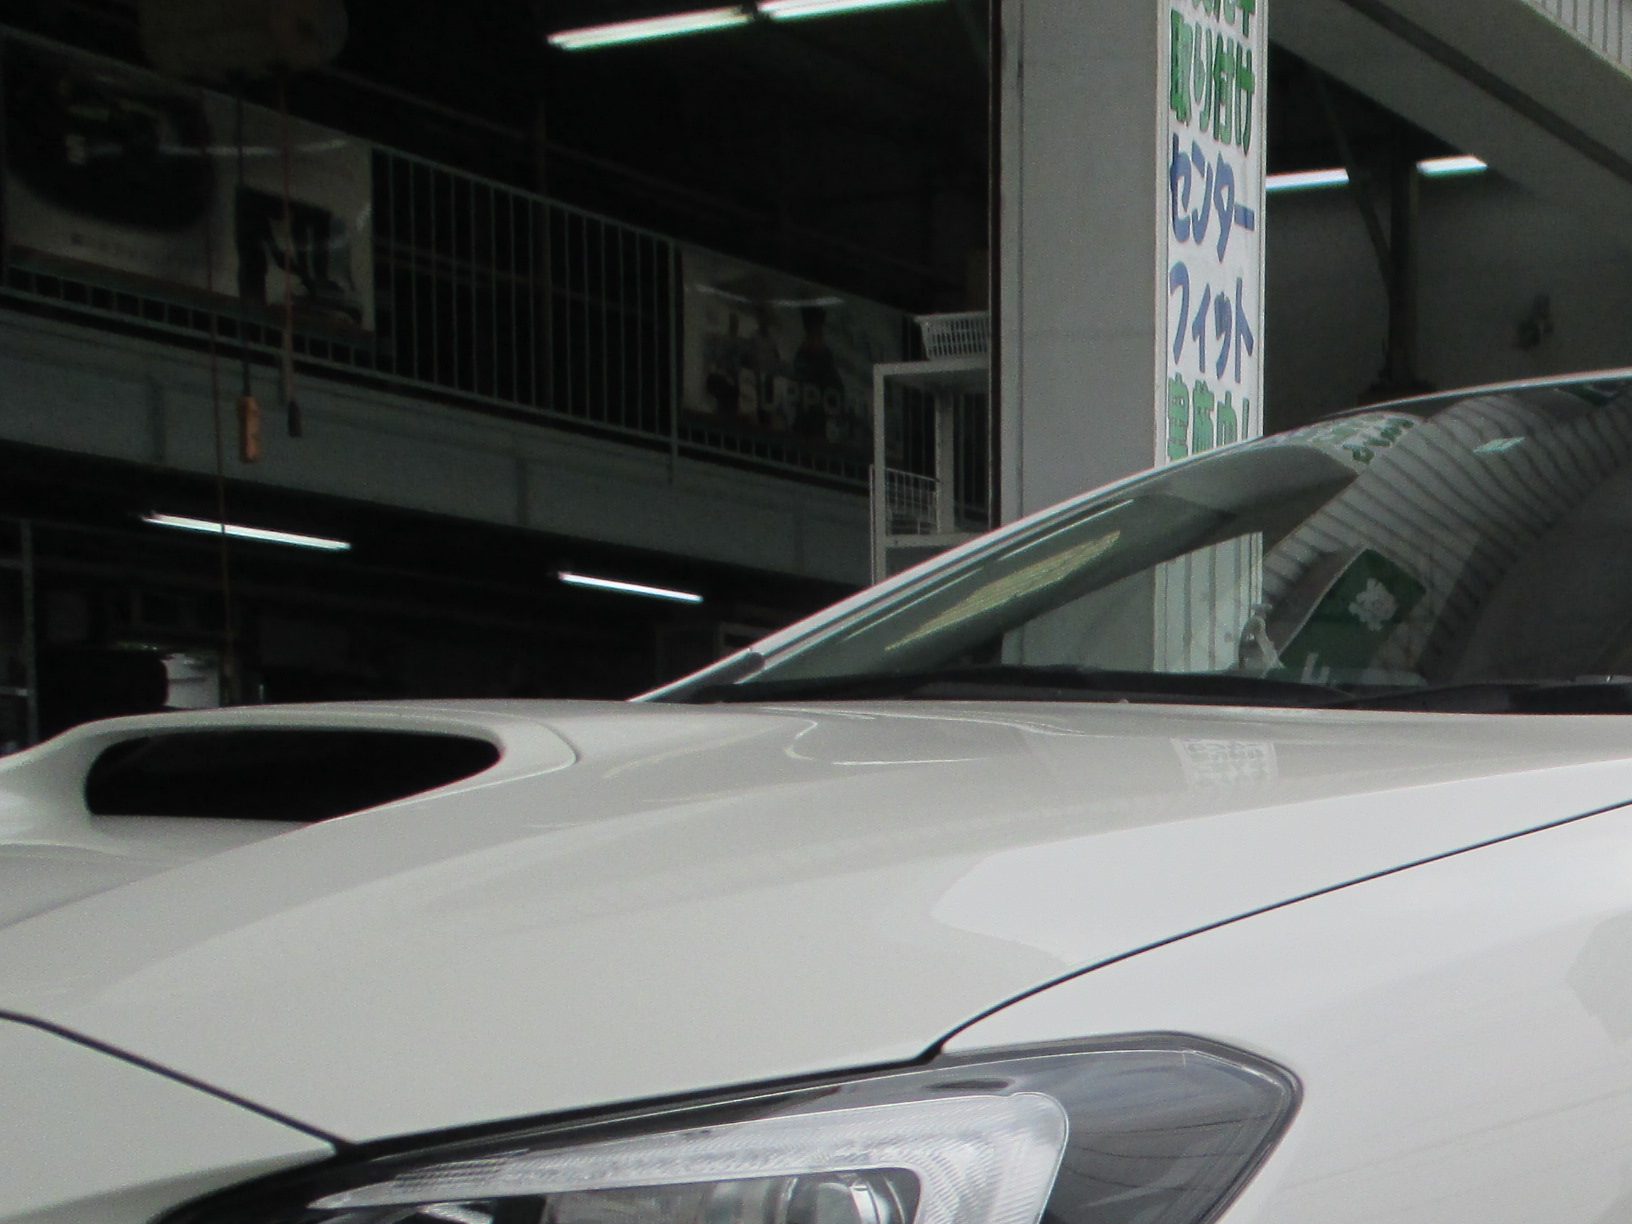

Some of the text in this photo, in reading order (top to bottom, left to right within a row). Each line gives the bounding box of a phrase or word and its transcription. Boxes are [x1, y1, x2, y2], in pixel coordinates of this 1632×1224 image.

[1169, 132, 1255, 262] センター
[1169, 261, 1254, 384] フィット
